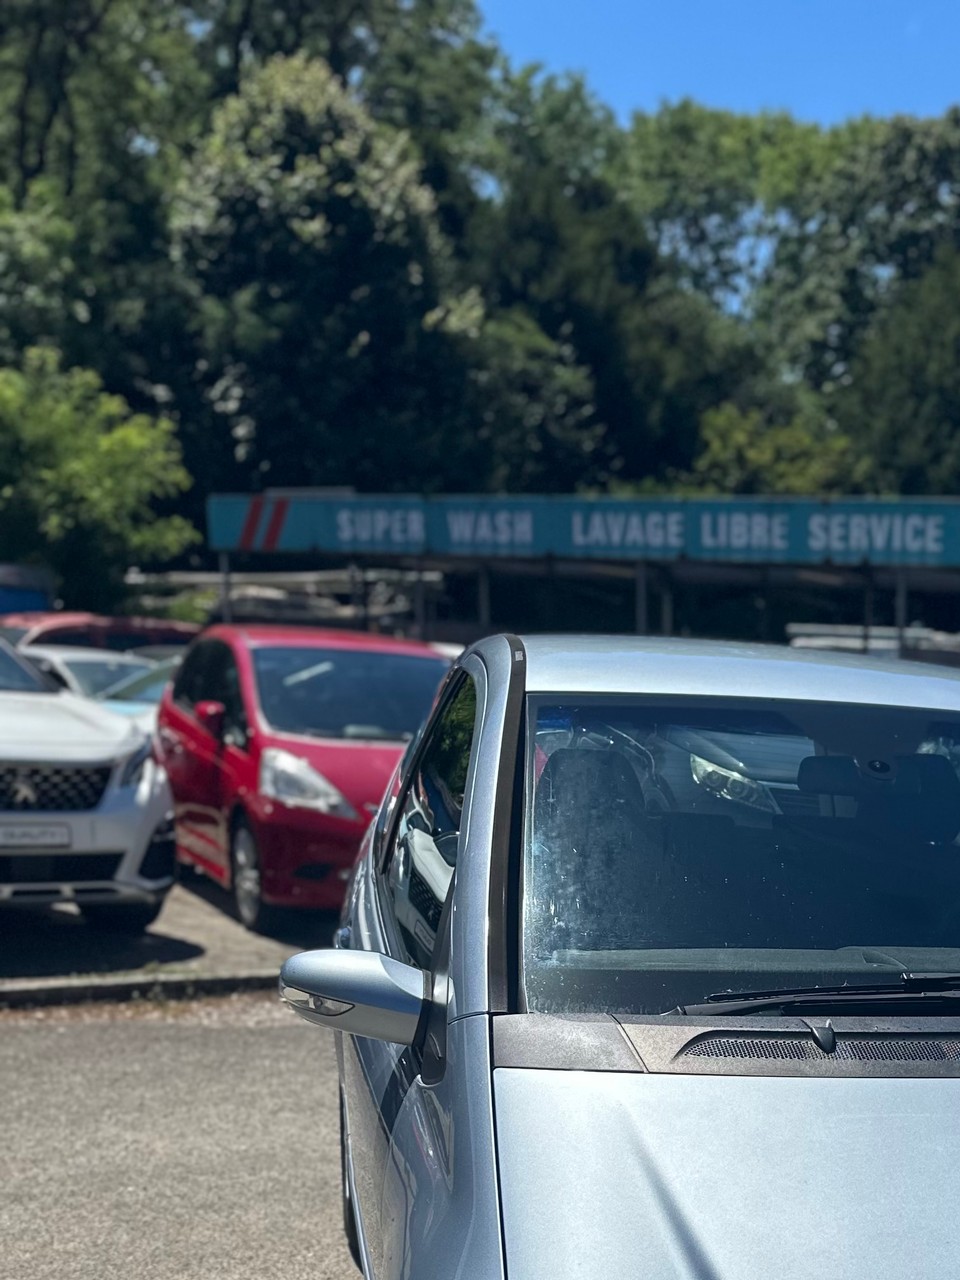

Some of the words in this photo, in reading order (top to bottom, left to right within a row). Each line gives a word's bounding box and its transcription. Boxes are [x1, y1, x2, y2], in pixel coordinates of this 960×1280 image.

[336, 510, 425, 542] SUPER
[447, 511, 533, 544] WASH
[572, 512, 684, 547] LAVAGE
[702, 513, 789, 550] LIBRE
[808, 514, 944, 552] SERVICE
